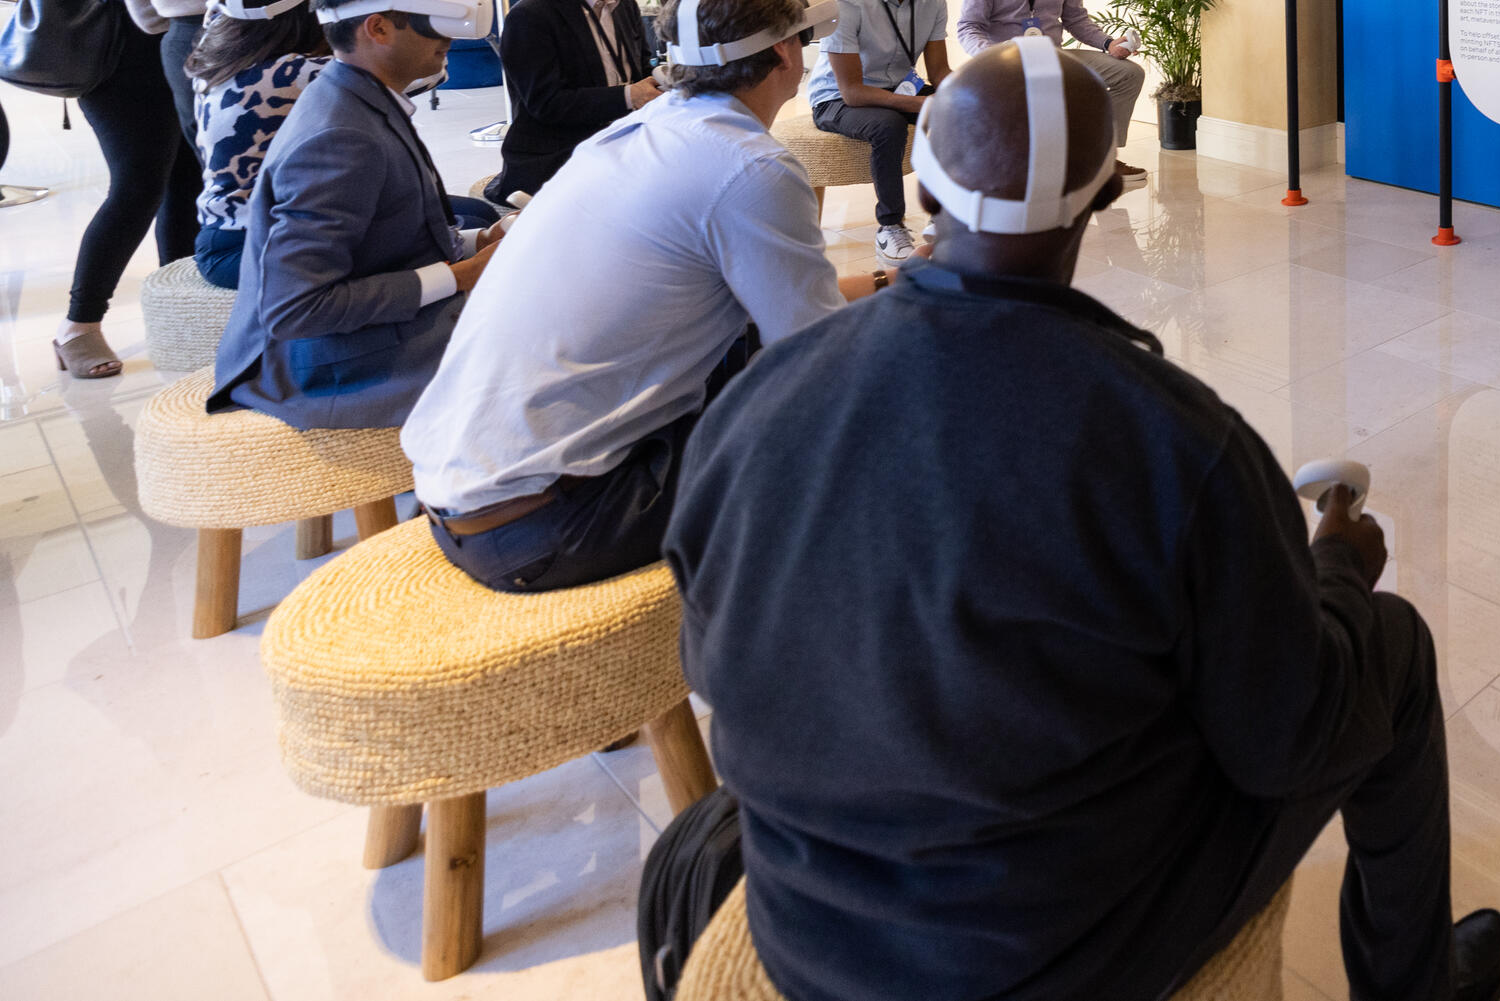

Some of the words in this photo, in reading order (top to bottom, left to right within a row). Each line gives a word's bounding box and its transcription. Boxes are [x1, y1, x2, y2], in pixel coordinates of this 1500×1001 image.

[1459, 0, 1477, 8] about
[1467, 30, 1481, 39] help
[1482, 32, 1500, 40] offset
[1459, 38, 1483, 48] minting
[1468, 46, 1487, 55] behalf
[1460, 52, 1488, 63] in-person
